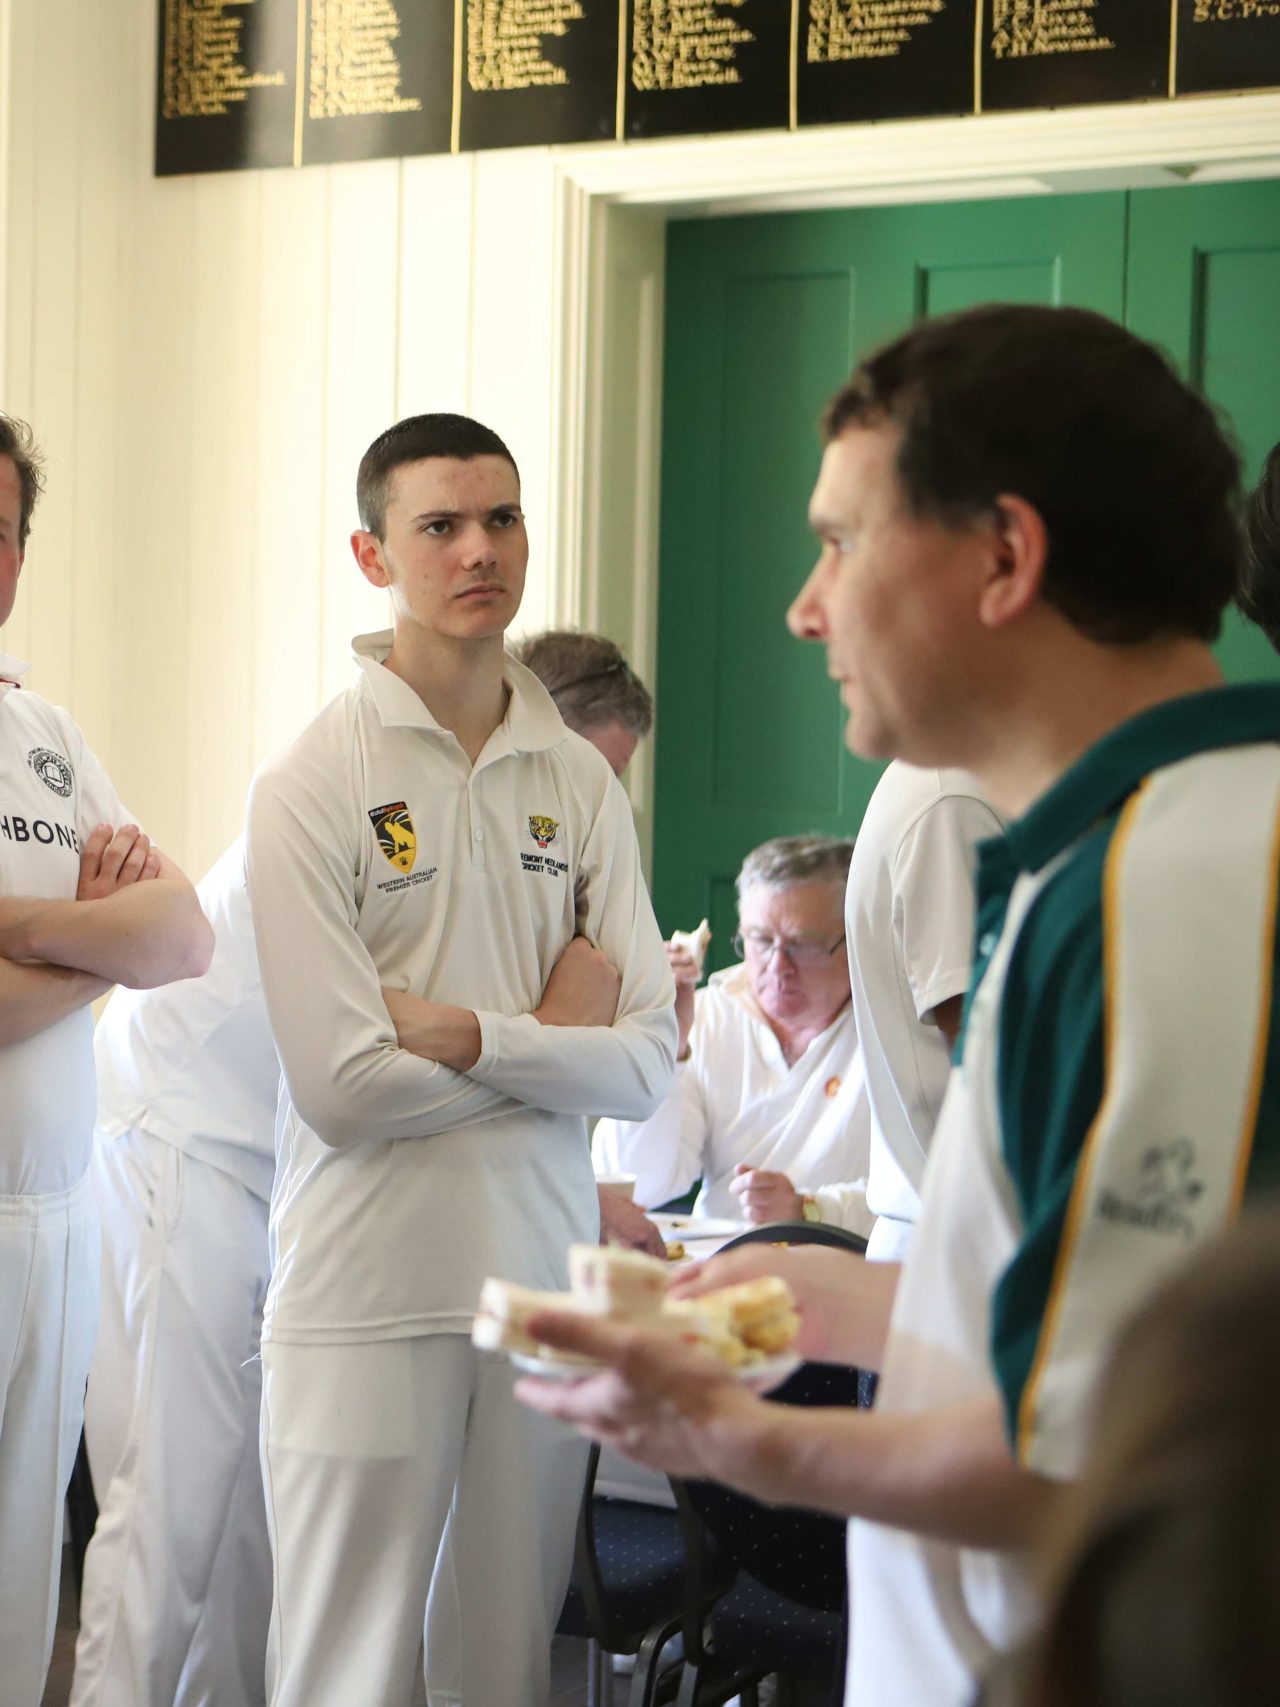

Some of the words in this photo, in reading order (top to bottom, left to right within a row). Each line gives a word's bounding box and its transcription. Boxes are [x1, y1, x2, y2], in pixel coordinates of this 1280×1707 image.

[377, 877, 405, 890] WESTERN
[406, 867, 437, 881] AUSTRALIAN
[385, 882, 410, 893] PREMIER
[412, 875, 433, 886] CRICKET
